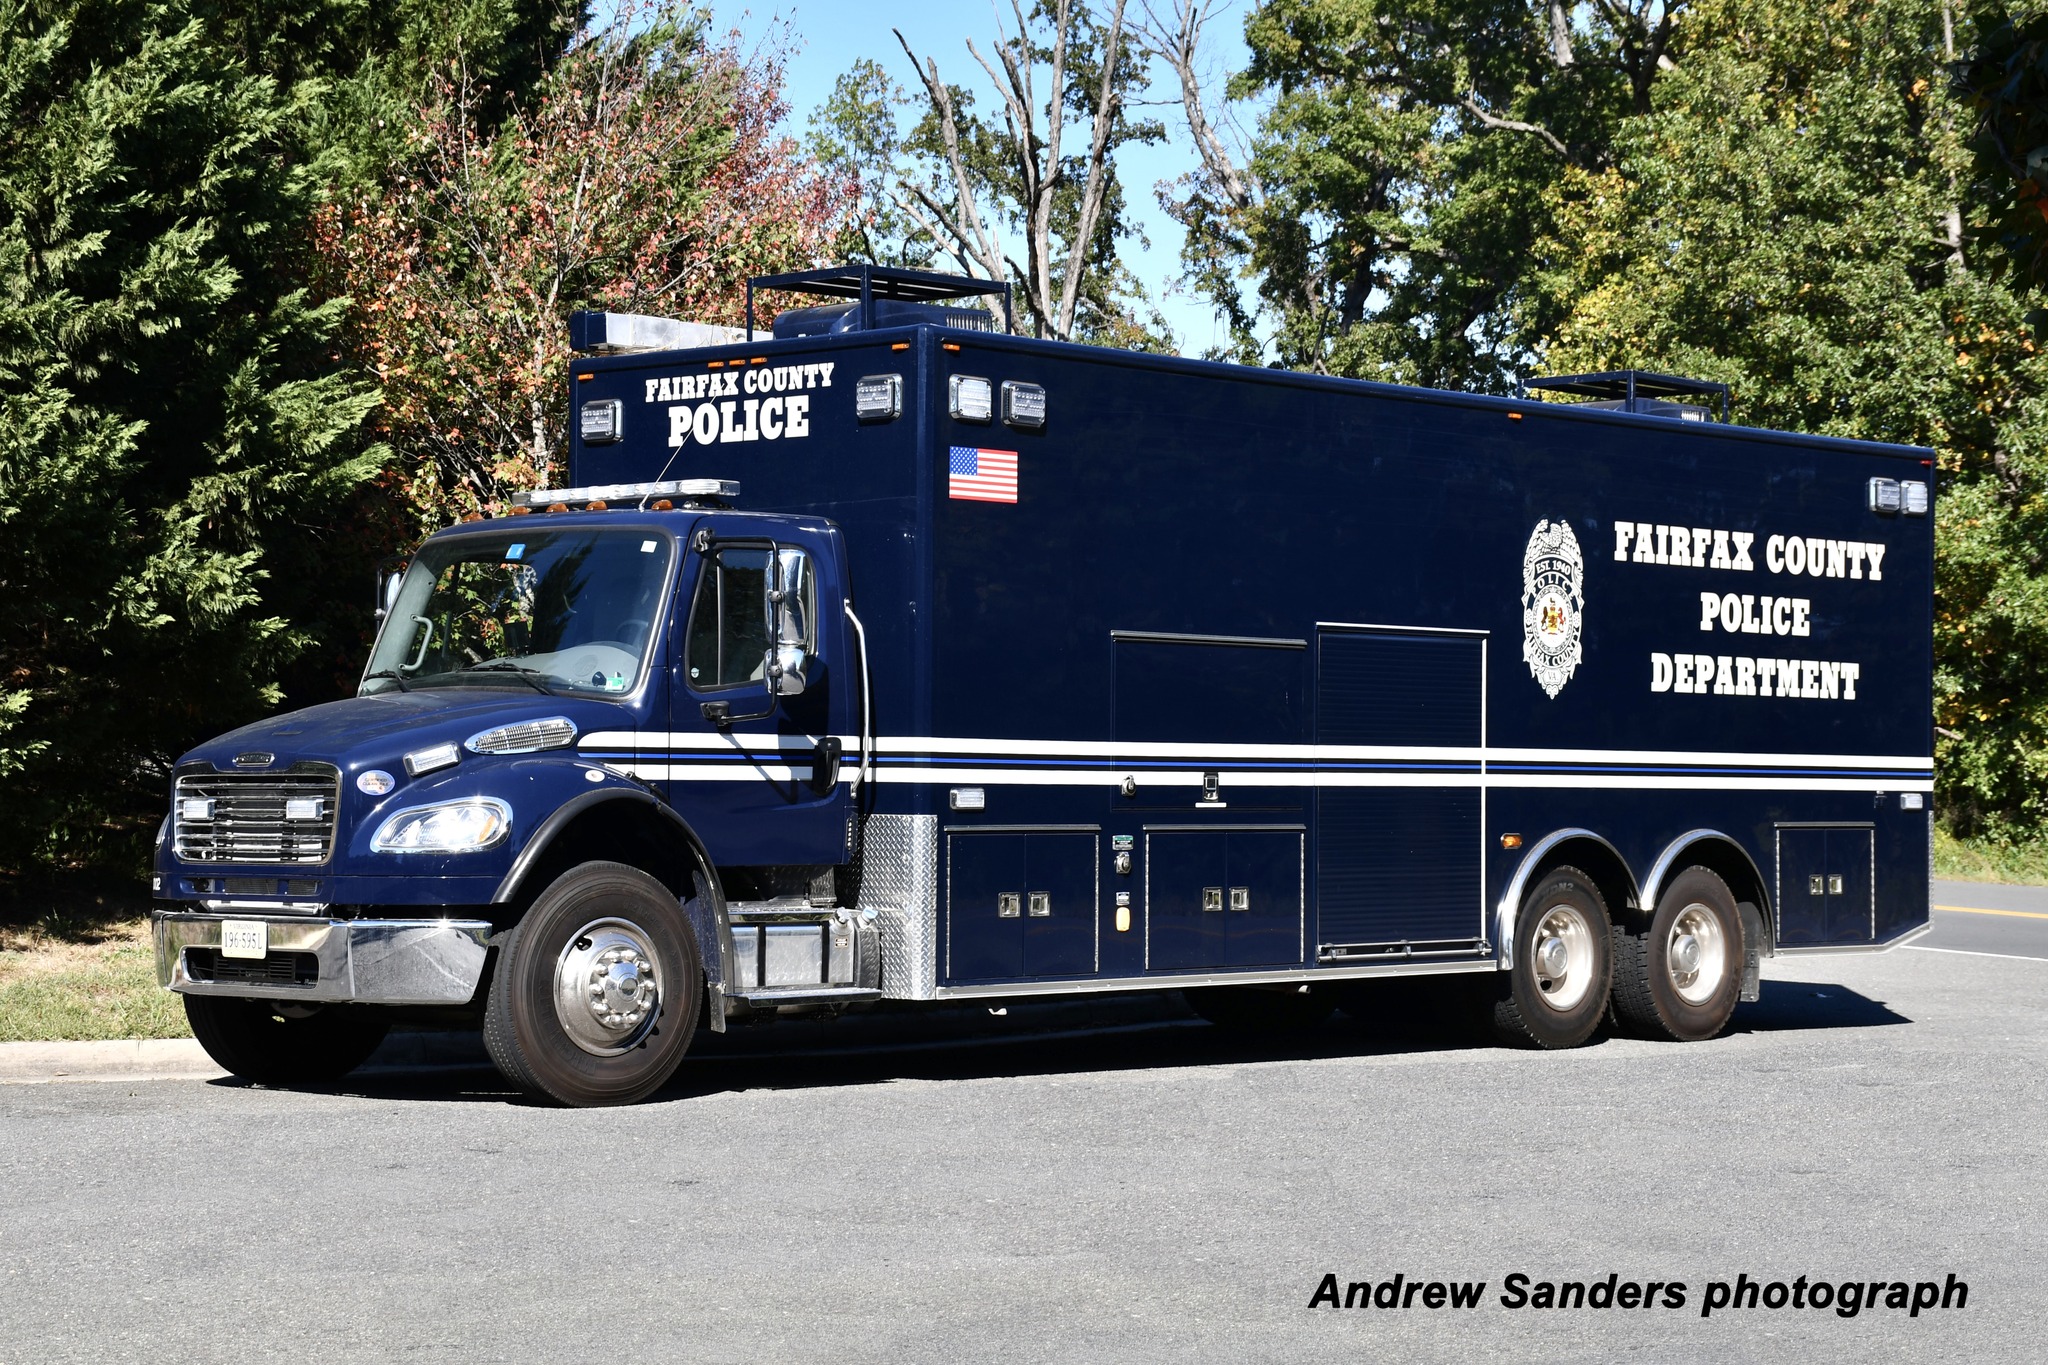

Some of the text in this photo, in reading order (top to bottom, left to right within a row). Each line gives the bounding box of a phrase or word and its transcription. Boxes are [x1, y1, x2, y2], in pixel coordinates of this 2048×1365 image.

[645, 361, 835, 403] FAIRFAX COUNTY
[667, 395, 809, 448] POLICE
[1552, 560, 1571, 576] 1940
[1614, 520, 1886, 581] FAIRFAX COUNTY
[1531, 573, 1575, 600] POLICE
[1700, 591, 1811, 637] POLICE
[1650, 652, 1860, 700] DEPARTMENT
